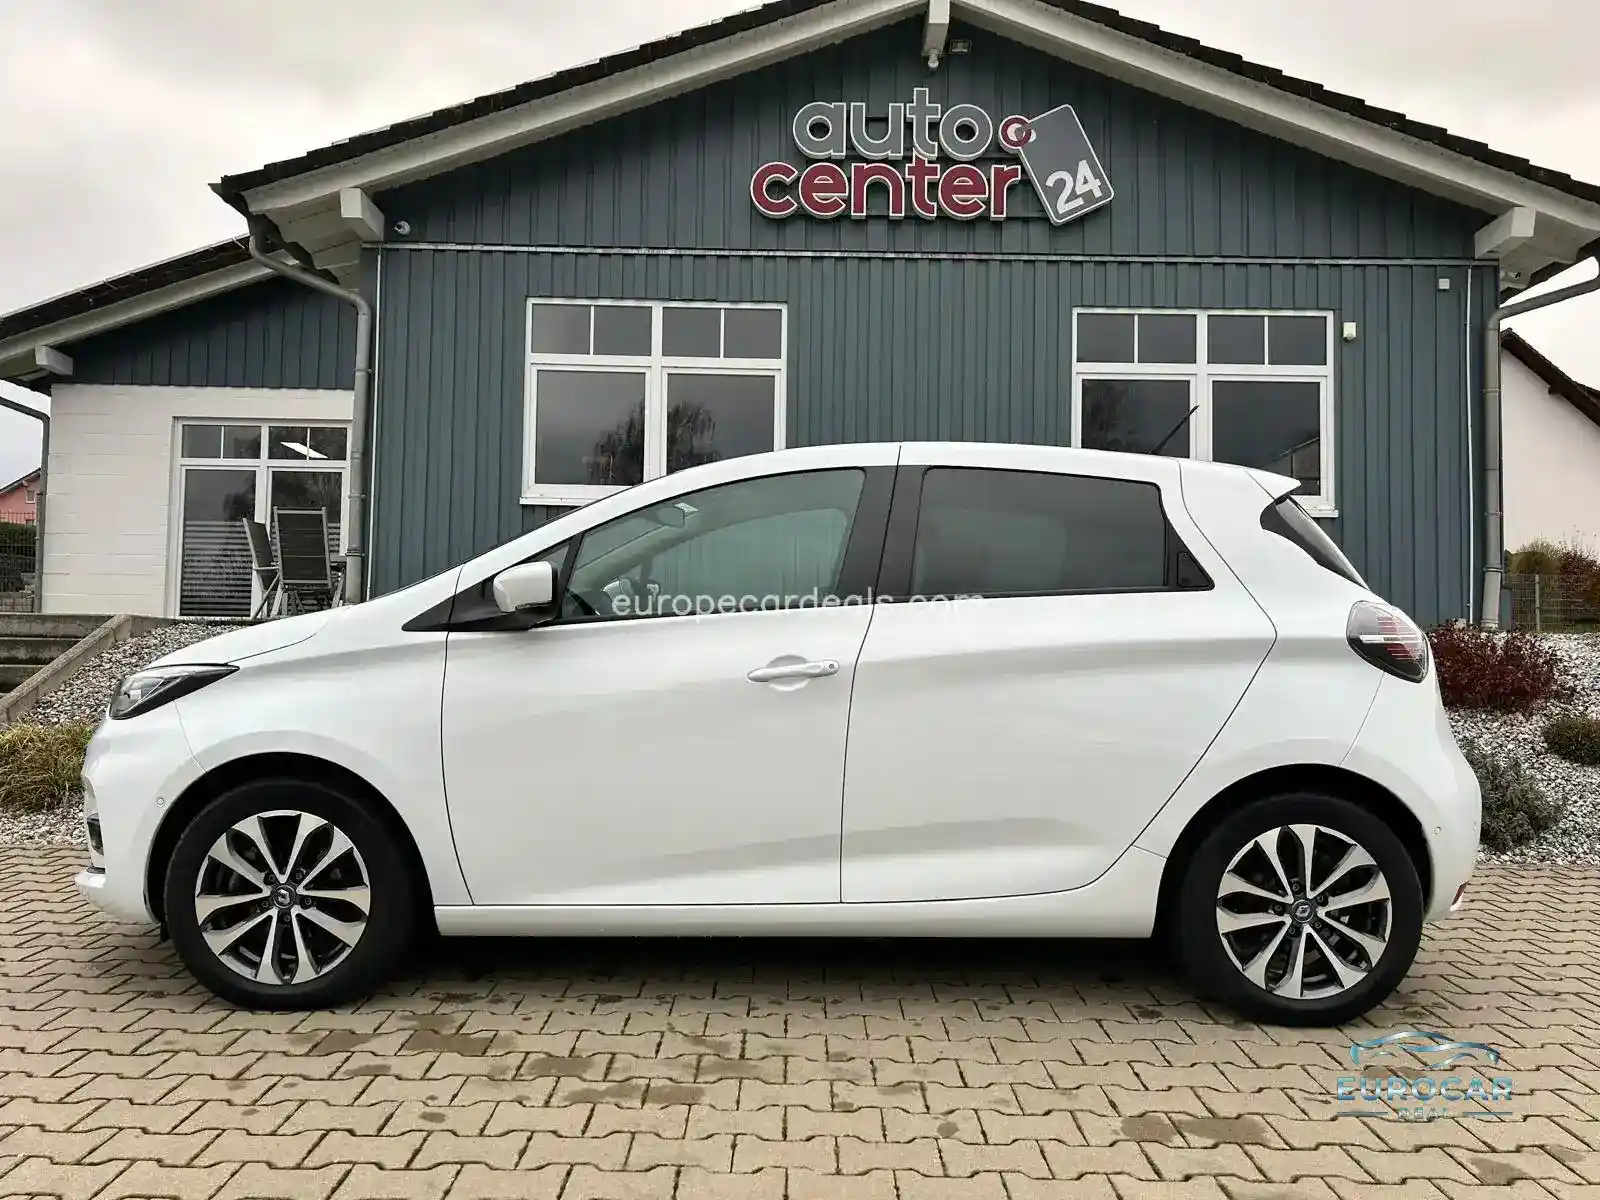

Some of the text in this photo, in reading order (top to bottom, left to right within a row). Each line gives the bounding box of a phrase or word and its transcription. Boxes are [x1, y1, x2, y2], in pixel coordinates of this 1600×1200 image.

[793, 87, 993, 160] auto
[750, 151, 1021, 221] center
[1045, 159, 1102, 215] 24
